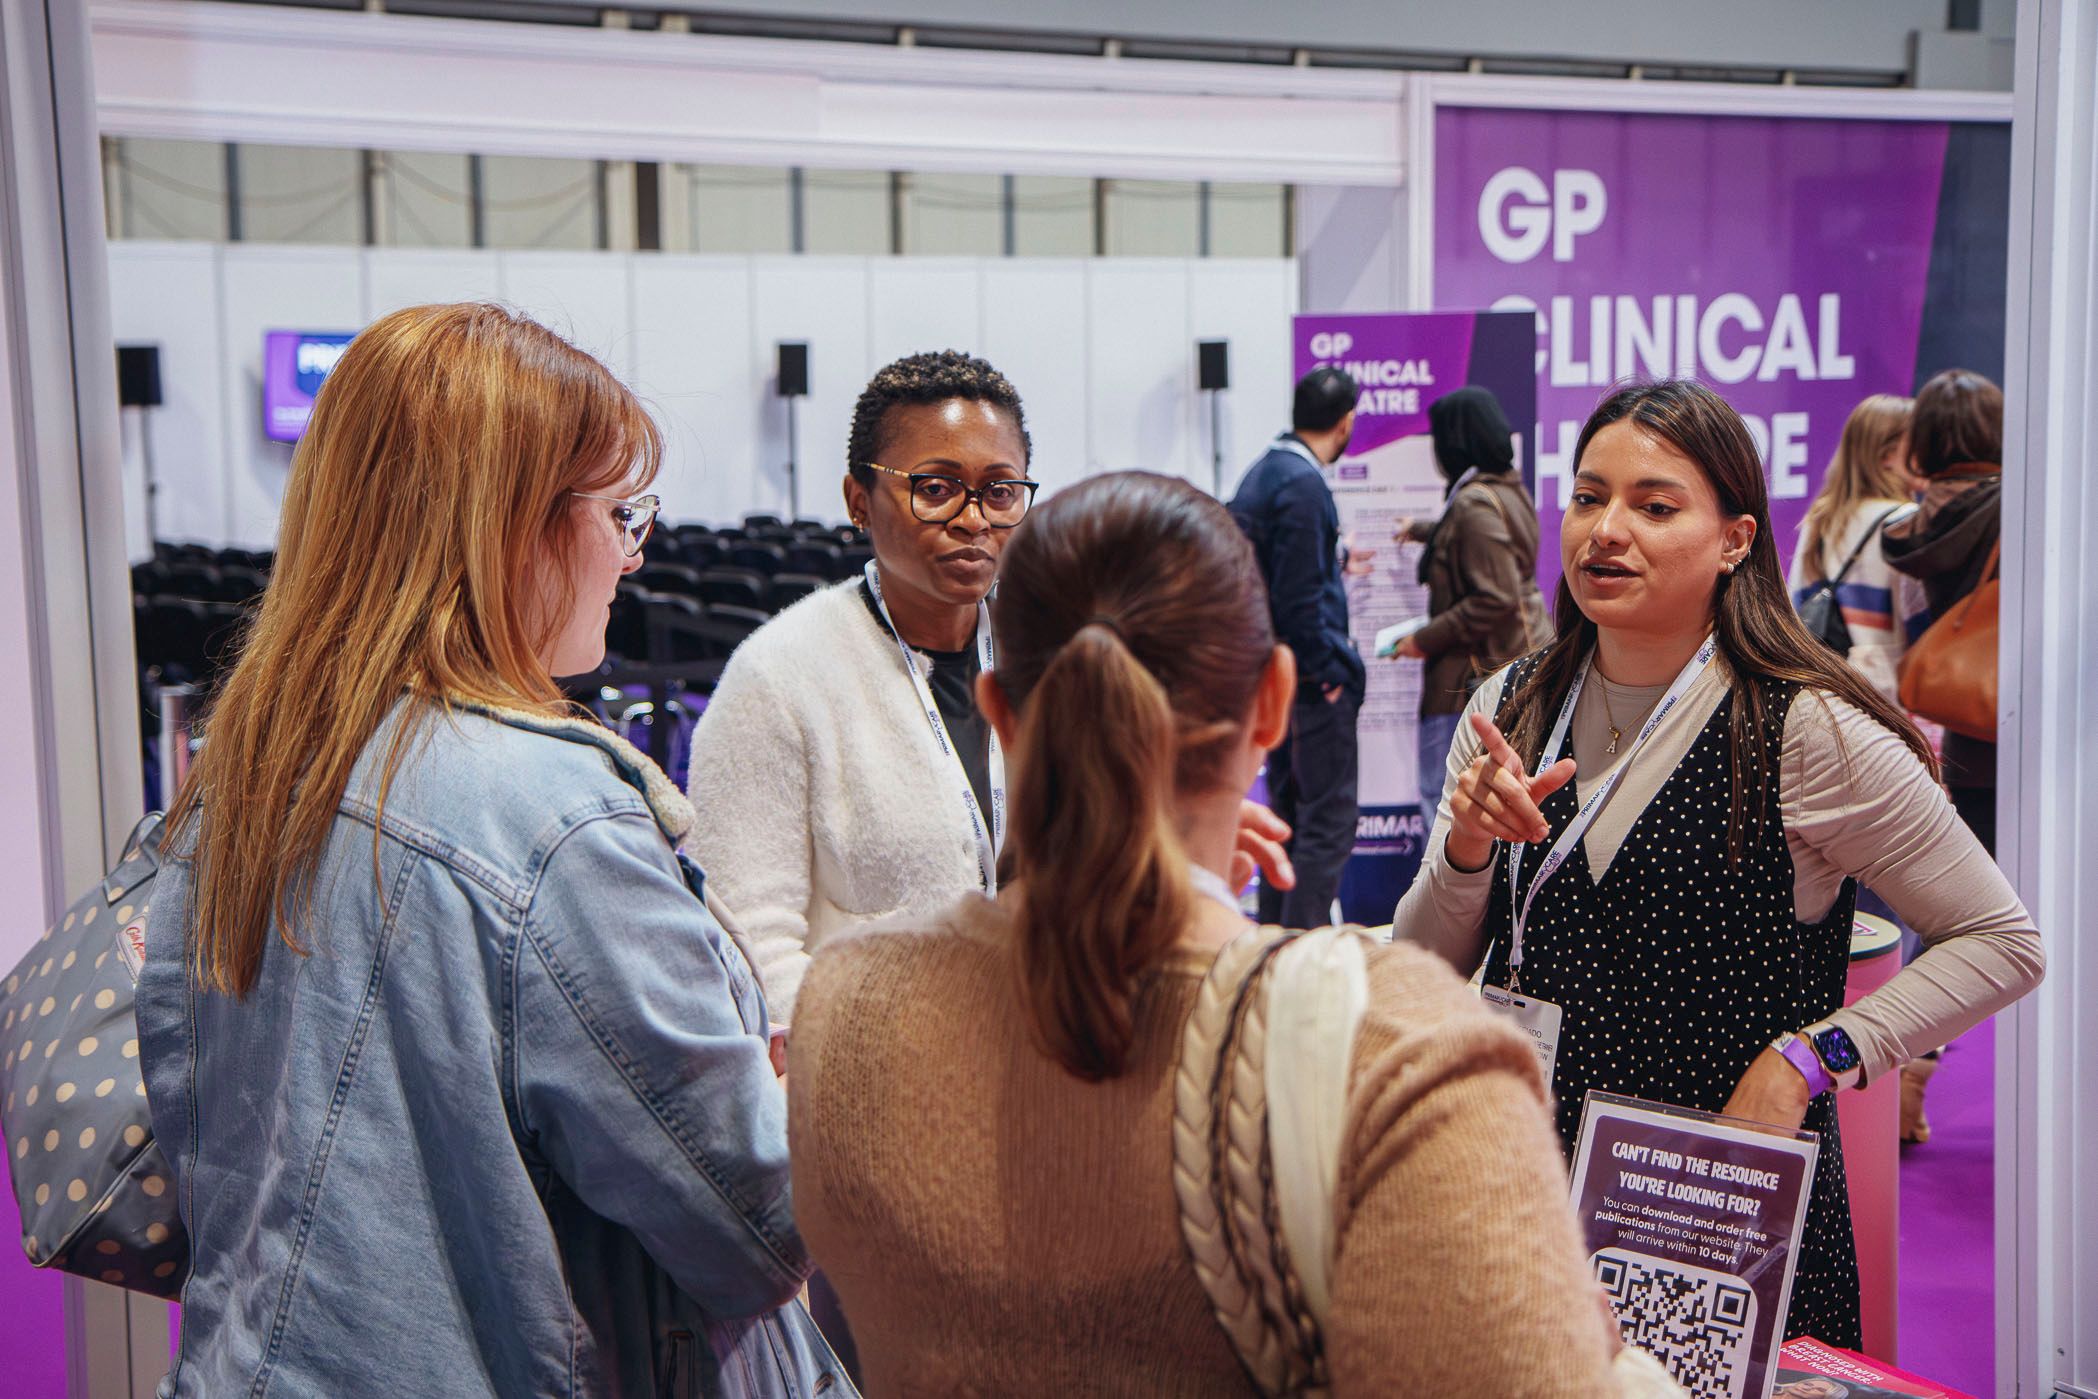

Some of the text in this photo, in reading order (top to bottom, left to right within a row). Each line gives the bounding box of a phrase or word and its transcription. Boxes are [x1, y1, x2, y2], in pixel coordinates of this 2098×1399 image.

[1477, 166, 1608, 264] GP
[1310, 332, 1353, 359] GP
[1312, 359, 1434, 386] INICAL
[1355, 388, 1420, 416] ATRE
[1355, 814, 1424, 838] RIMAR
[1612, 1141, 1780, 1191] CAN'T FIND THE RESOURCE
[1620, 1171, 1761, 1216] YOU'RE LOOKING FOR?
[1595, 1210, 1769, 1258] publications from our website. They
[1603, 1196, 1767, 1241] You can download and order free
[1618, 1230, 1739, 1264] will arrive within 10 days.
[1780, 1347, 1811, 1362] WHAT
[1788, 1344, 1830, 1363] BREAST
[1797, 1342, 1884, 1381] DIAGNOSED WITH
